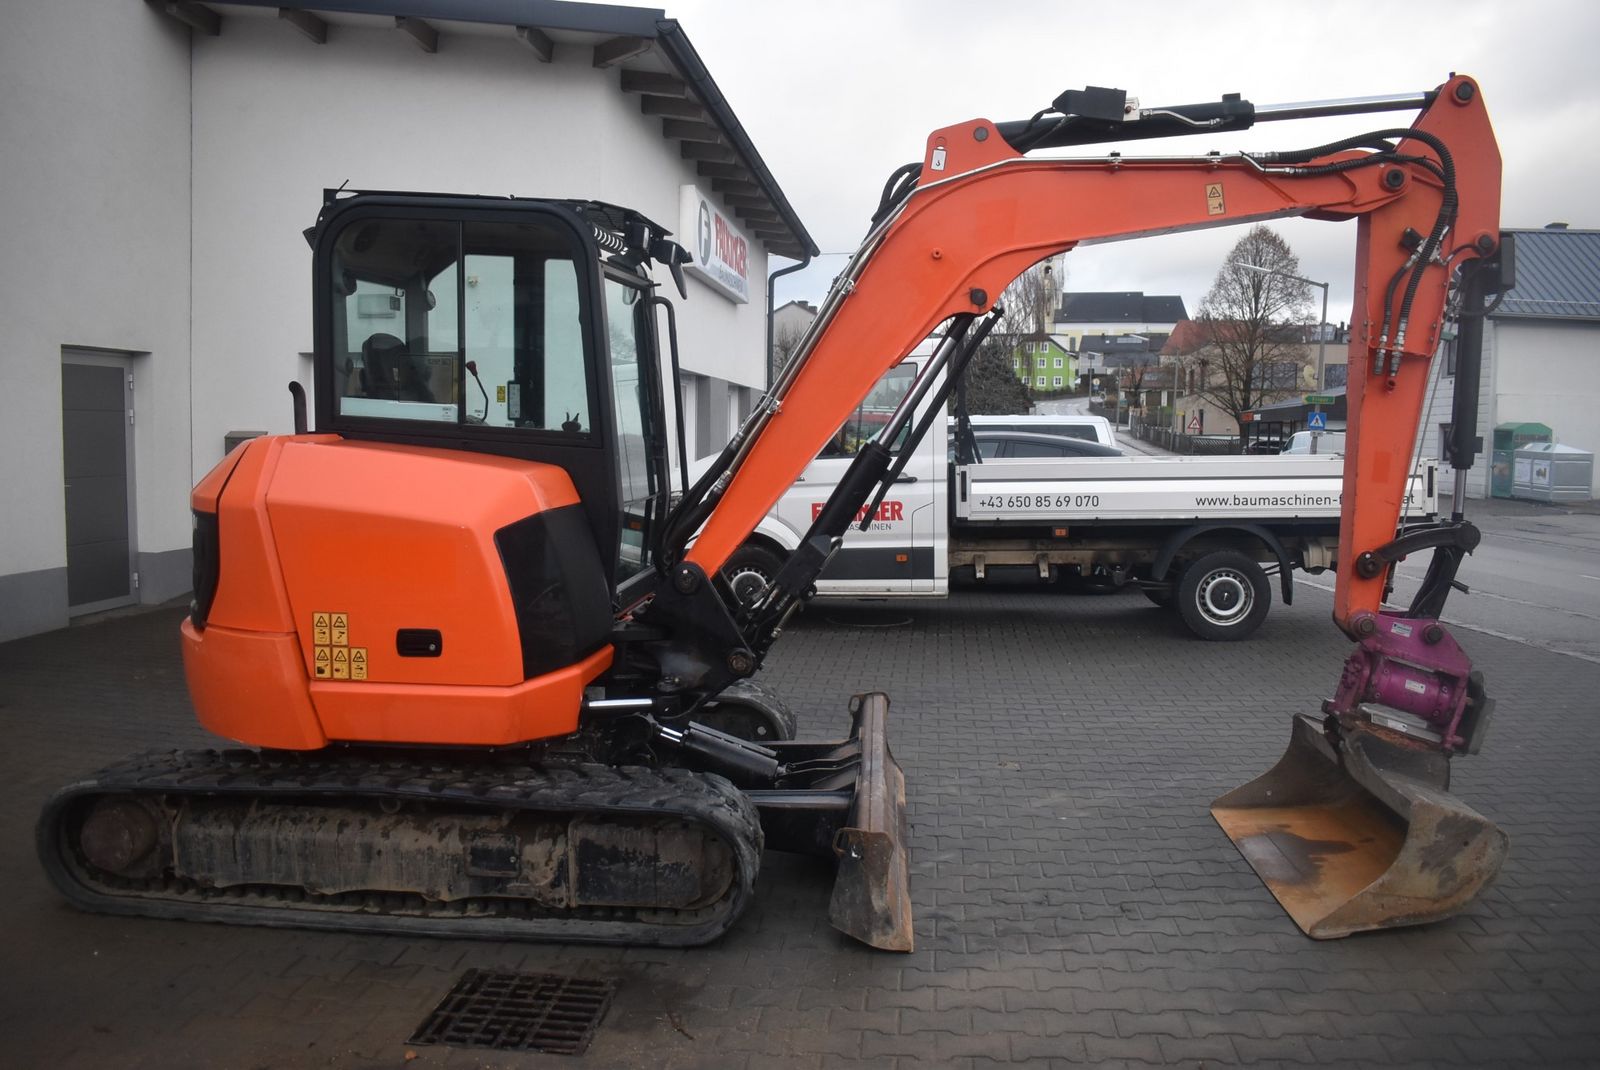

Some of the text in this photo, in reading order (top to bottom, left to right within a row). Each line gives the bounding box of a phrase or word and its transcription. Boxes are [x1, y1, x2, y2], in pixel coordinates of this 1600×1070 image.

[979, 495, 1099, 508] +43 650 85 69 070
